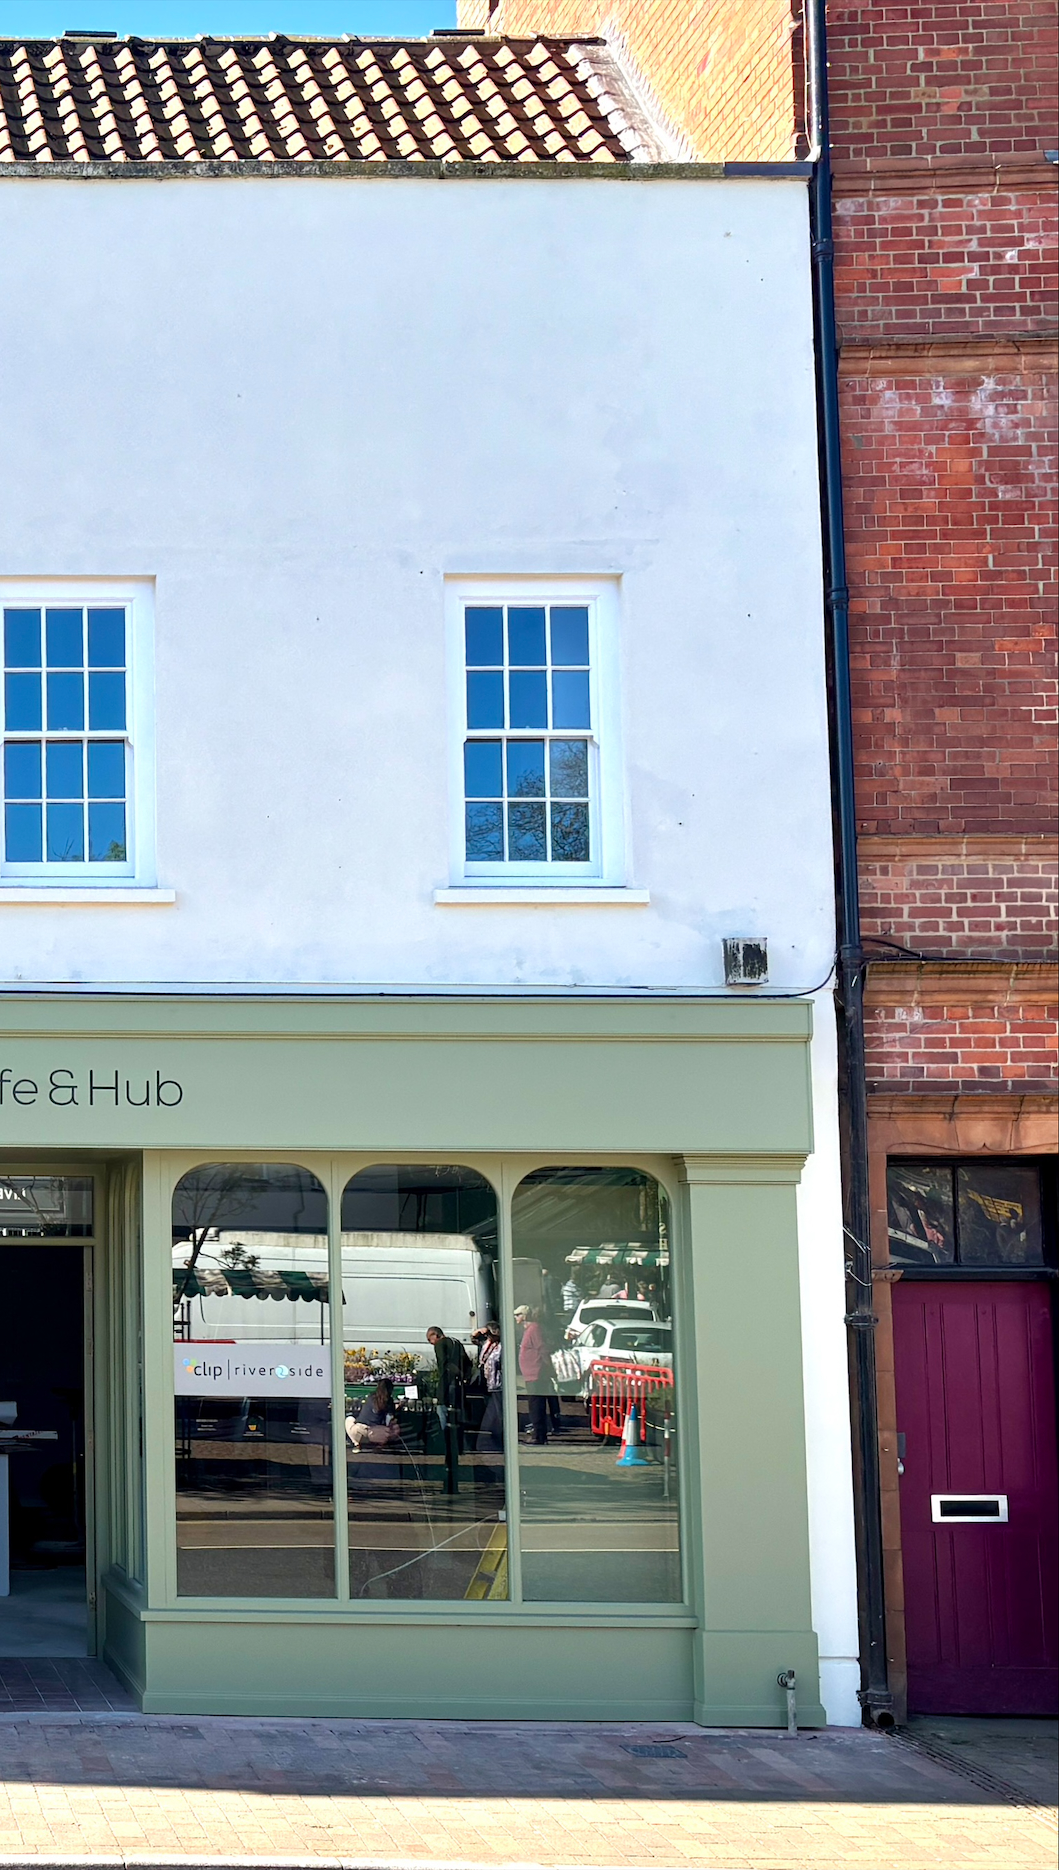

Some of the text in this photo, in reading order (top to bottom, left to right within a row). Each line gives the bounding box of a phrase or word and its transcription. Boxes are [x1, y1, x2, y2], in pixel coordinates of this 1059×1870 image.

[48, 1069, 79, 1106] &
[89, 1069, 183, 1106] Hub
[194, 1361, 222, 1380] clip
